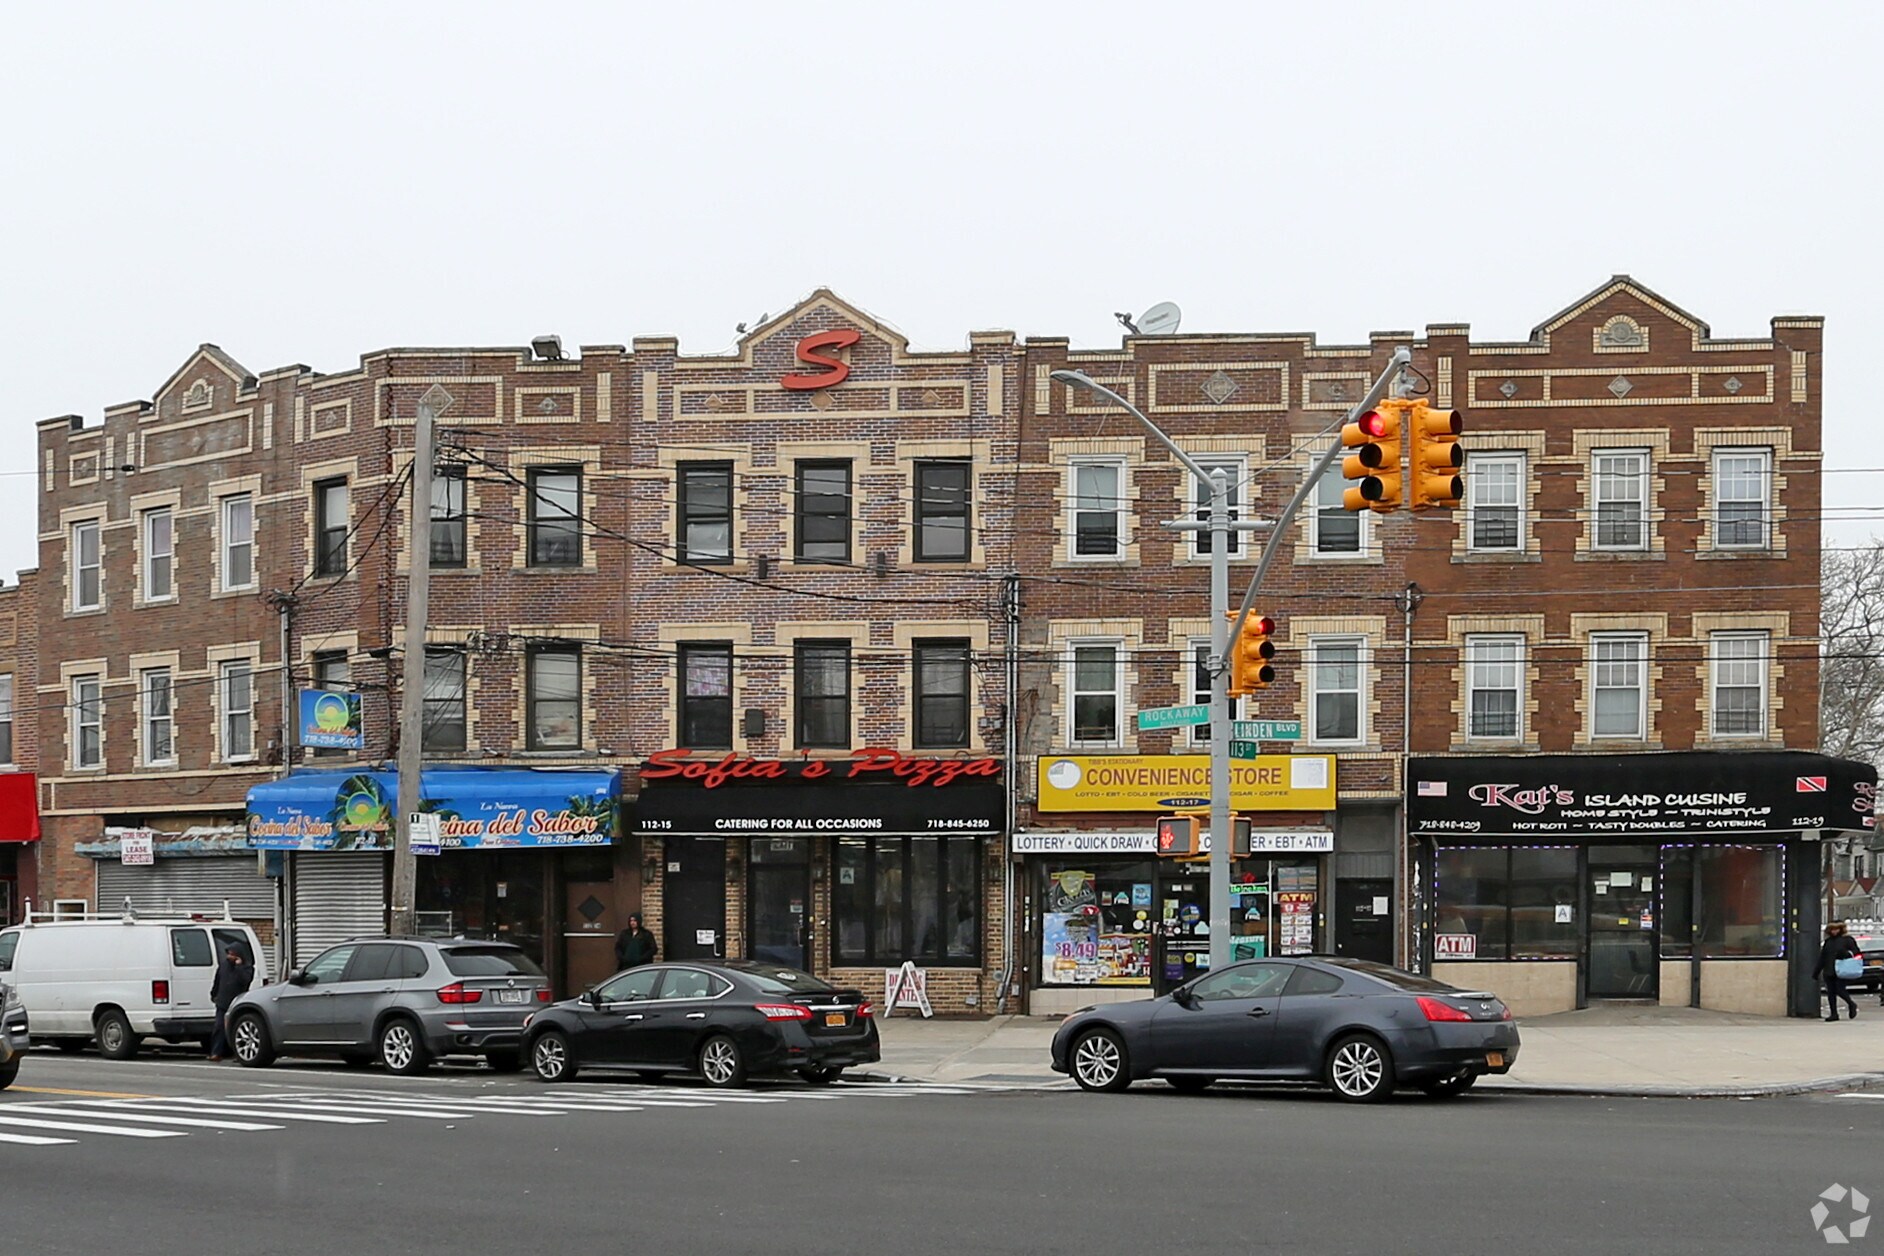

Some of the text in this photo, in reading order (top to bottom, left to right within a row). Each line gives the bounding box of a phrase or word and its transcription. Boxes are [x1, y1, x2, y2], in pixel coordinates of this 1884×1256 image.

[781, 328, 861, 390] S
[1144, 706, 1205, 722] ROCKAWAY
[1235, 722, 1297, 738] LINDEN BLVD
[1230, 742, 1244, 757] 113
[640, 748, 1001, 788] Sofia's Pizza
[1087, 768, 1281, 786] CONVENIENCE TORE
[1468, 784, 1574, 814] Kat's
[1585, 793, 1746, 808] ISLAND CUISINE
[1560, 810, 1605, 818] HOME
[1607, 808, 1658, 819] STYLE
[250, 814, 332, 837] Cocina del Sabor
[487, 806, 526, 838] del
[528, 808, 598, 836] Sabor
[641, 820, 672, 829] 112-15
[715, 818, 882, 830] CATERING FOR ALL OCCASIONS
[928, 819, 990, 829] 718-845-6250
[1513, 820, 1766, 832] HOT ROTI TASTY DOUBLES CATERING
[1792, 816, 1825, 828] 112-19
[1017, 837, 1064, 849] LOTTERY
[1075, 837, 1107, 850] QUICK
[1111, 837, 1143, 849] DRAW
[1275, 837, 1296, 849] EBT
[1304, 836, 1327, 848] ATM
[1280, 893, 1313, 902] ATM
[1056, 941, 1096, 959] $8.49
[1438, 936, 1472, 952] ATM
